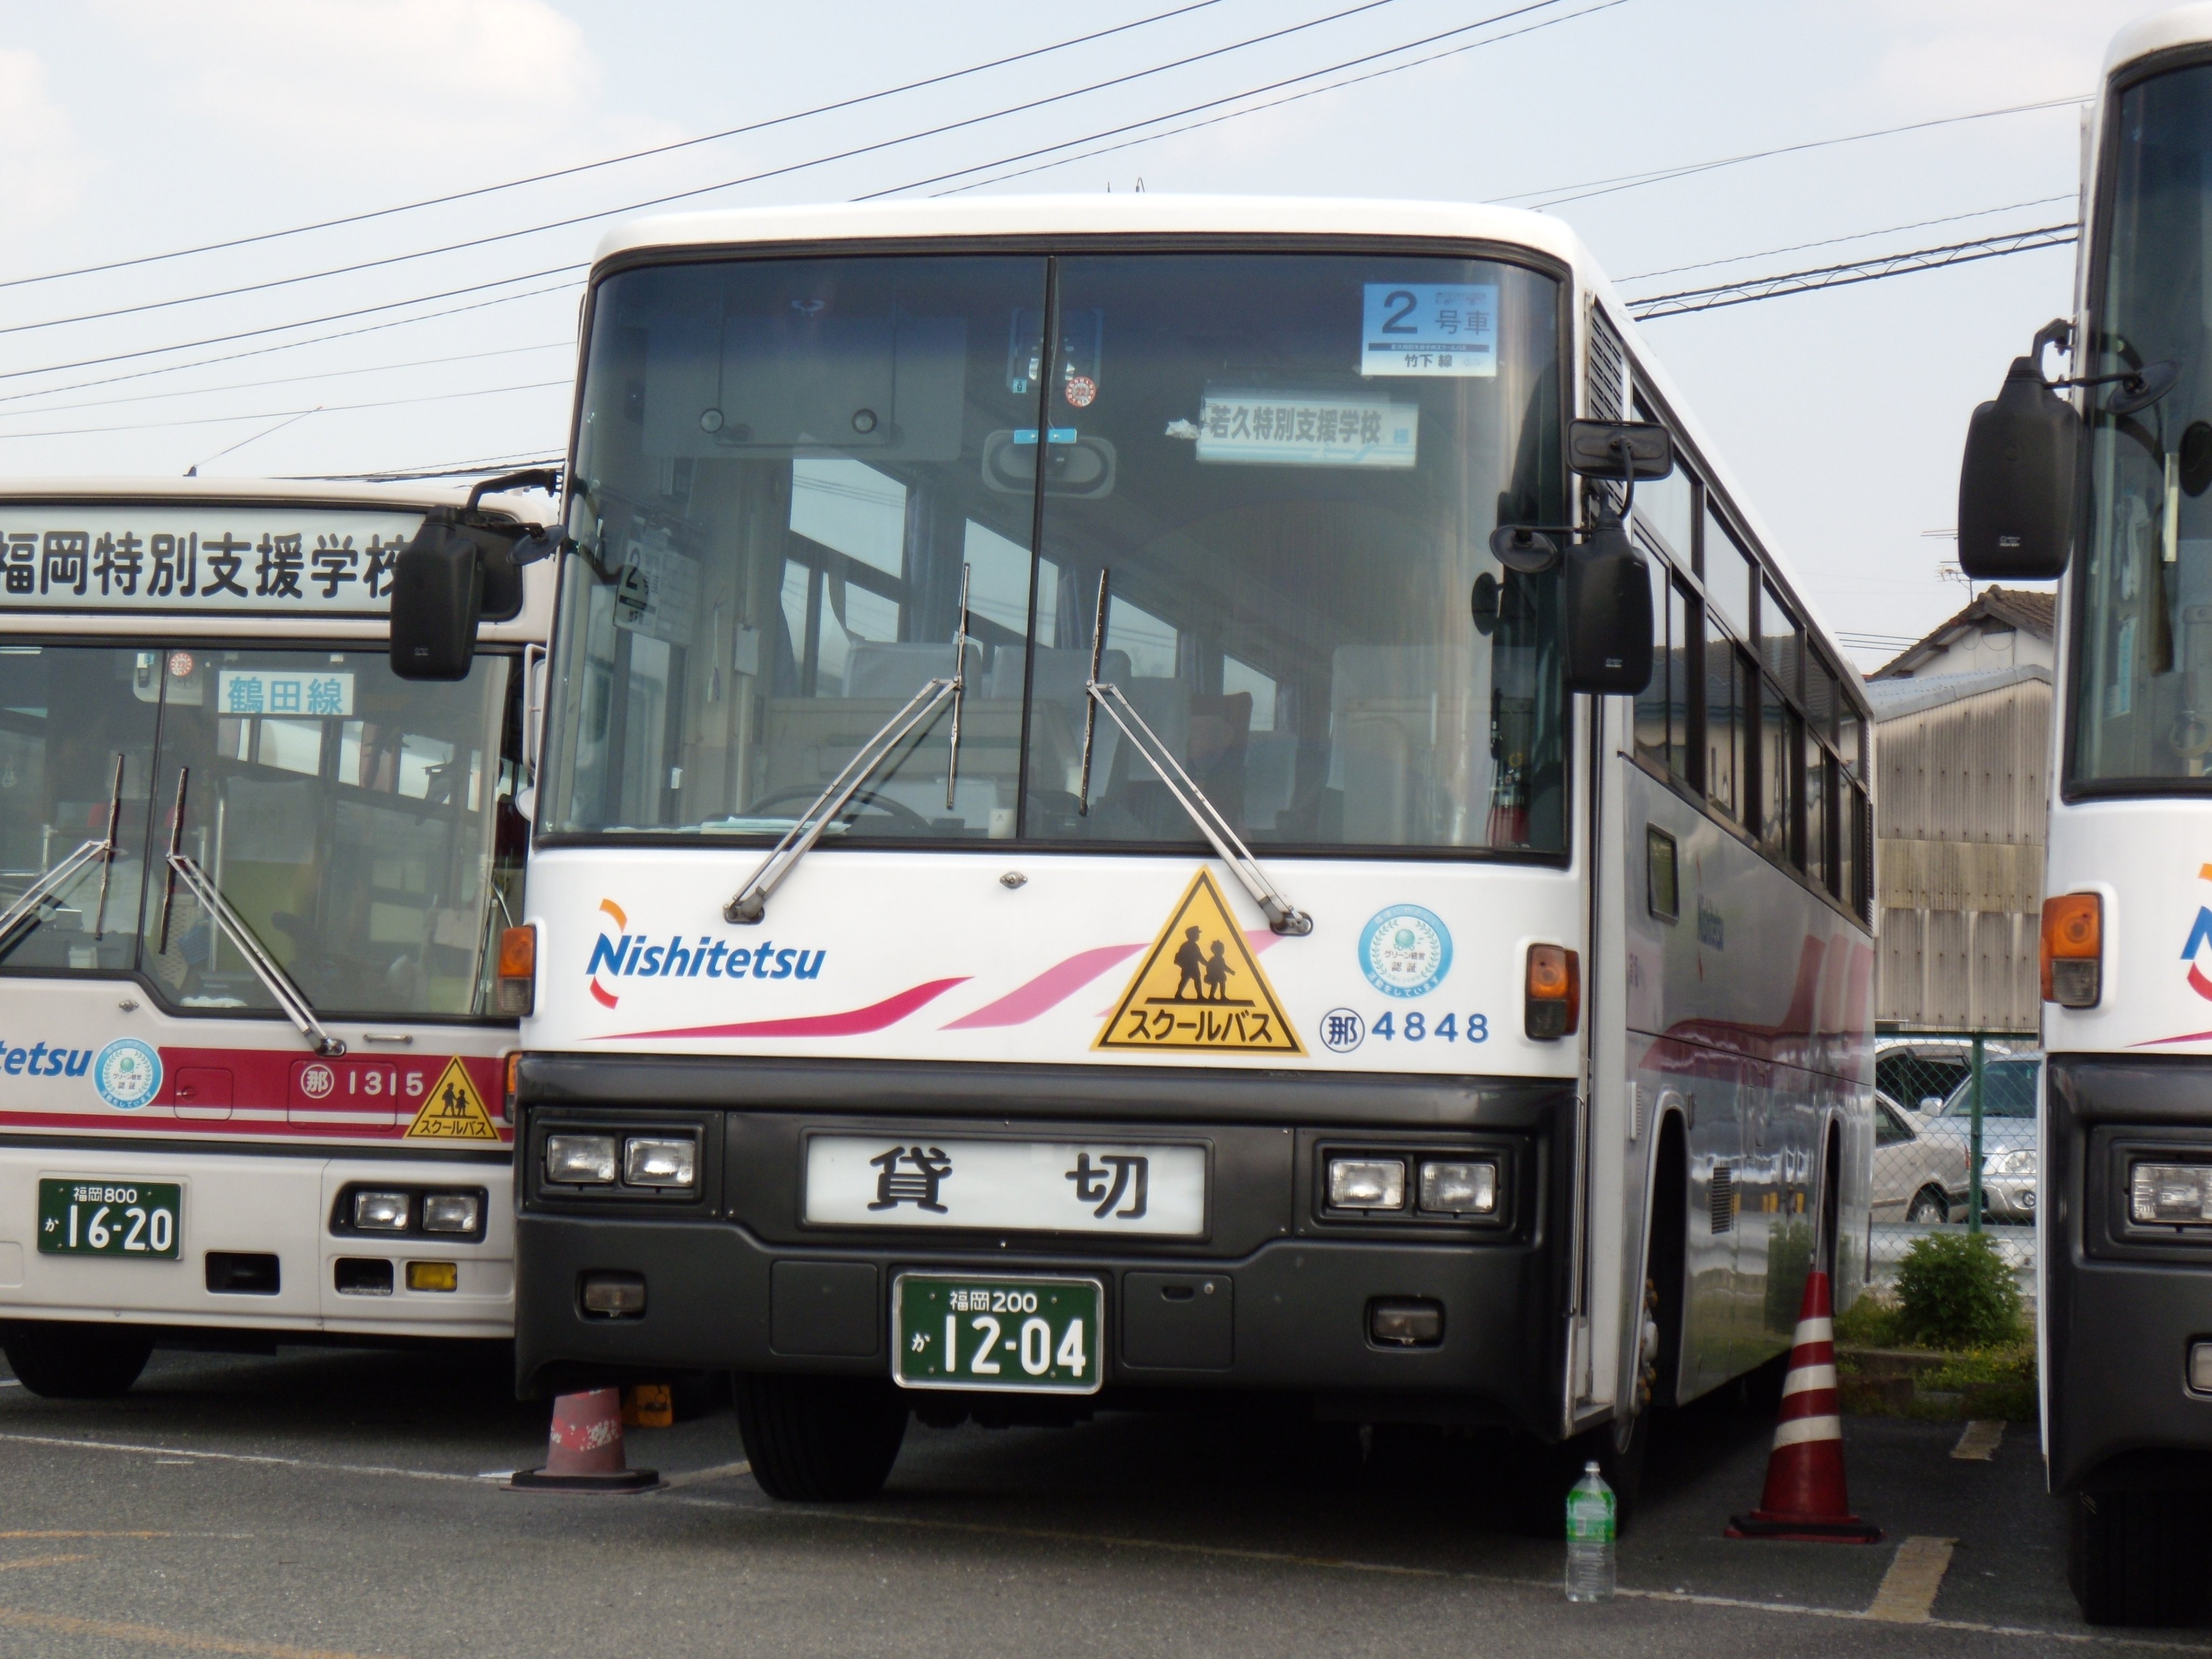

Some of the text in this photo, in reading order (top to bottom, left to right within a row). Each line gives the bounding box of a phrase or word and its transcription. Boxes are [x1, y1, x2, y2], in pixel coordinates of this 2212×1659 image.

[1382, 291, 1490, 335] 2 号車
[1210, 405, 1382, 444] 若久特別支援学校
[227, 676, 343, 715] 鶴田線
[585, 932, 827, 980] Nishitetsu
[1128, 1009, 1273, 1043] スクールバス
[1372, 1011, 1489, 1043] 4848
[349, 1071, 423, 1096] 1315
[420, 1120, 487, 1136] スクールバス
[45, 1205, 173, 1251] か 16-20
[911, 1315, 1086, 1377] か 12-04
